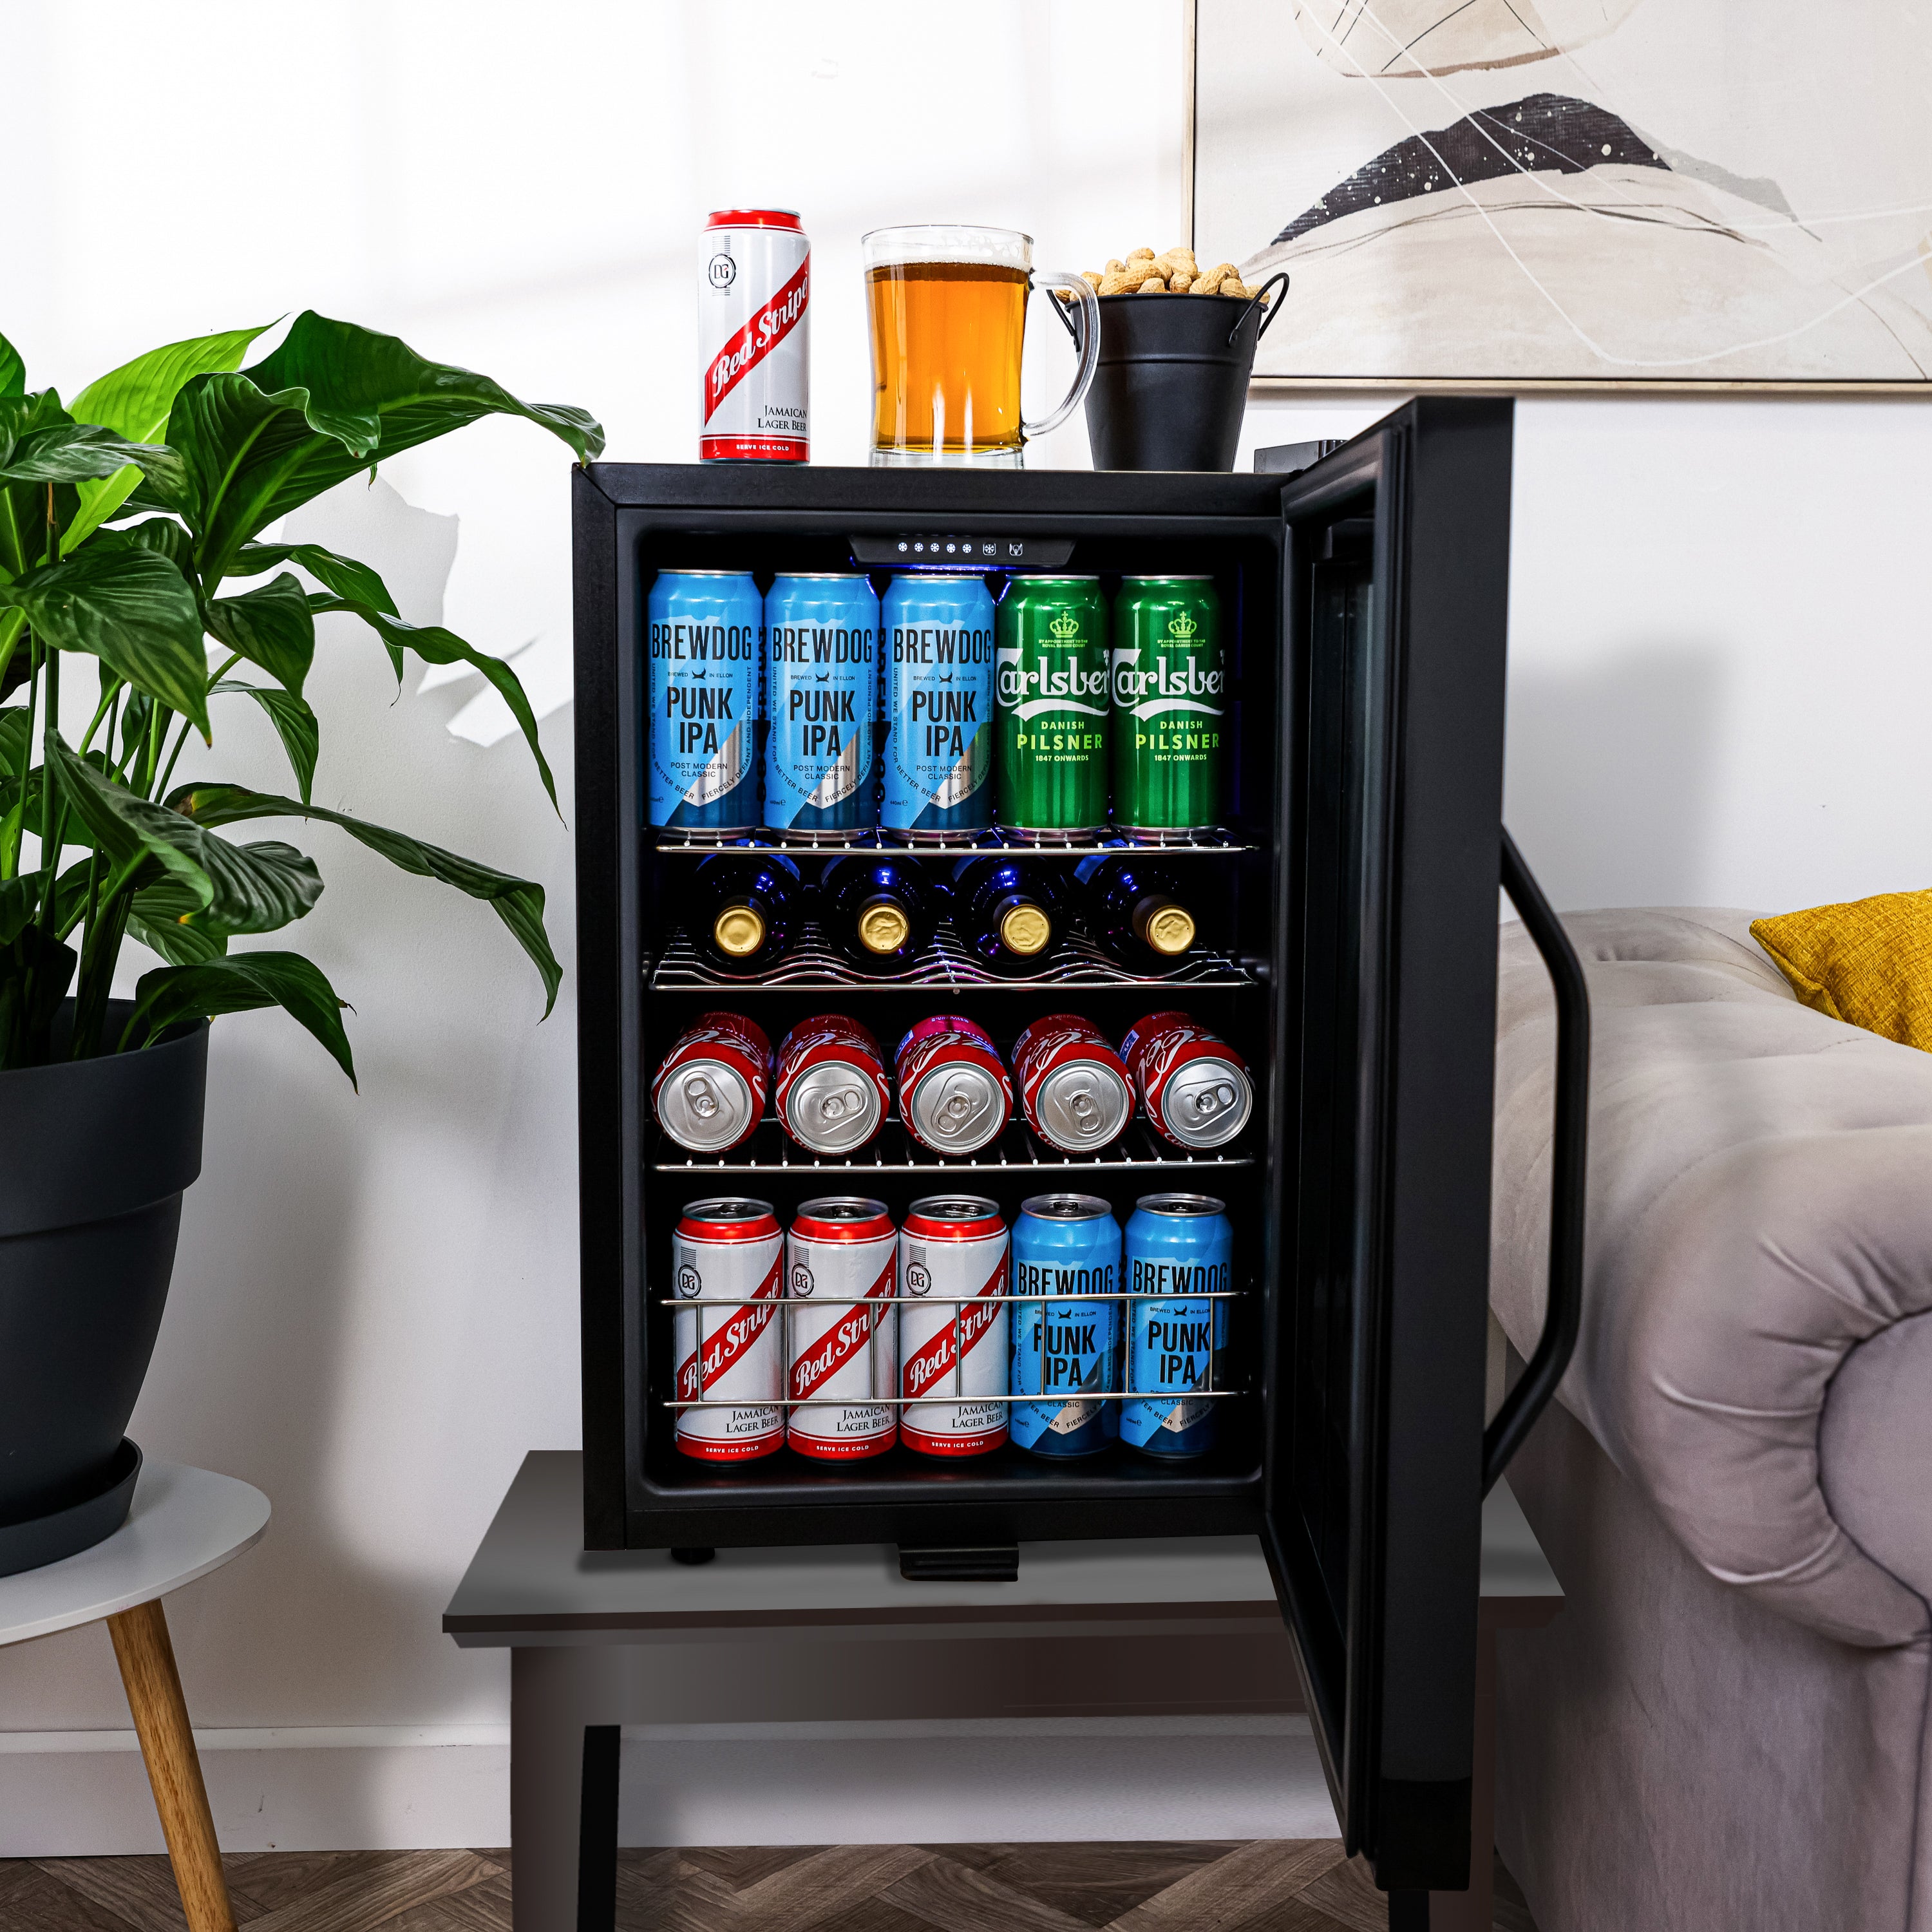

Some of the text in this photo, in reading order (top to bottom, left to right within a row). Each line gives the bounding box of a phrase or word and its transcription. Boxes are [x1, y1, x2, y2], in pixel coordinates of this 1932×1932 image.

[712, 277, 808, 397] Red Stripe
[757, 418, 807, 431] LAGER BEER
[764, 405, 807, 419] JAMAICAN
[652, 623, 752, 661] BREWDOG
[773, 627, 872, 663] BREWDOG
[894, 629, 991, 664] BREWDOG
[667, 687, 733, 719] PUNK
[790, 690, 855, 722] PUNK
[912, 690, 977, 722] PUNK
[679, 722, 719, 754] IPA
[803, 724, 842, 756] IPA
[926, 725, 964, 757] IPA
[1041, 721, 1084, 730] DANISH
[1160, 721, 1202, 729] DANISH
[772, 700, 777, 712] WE
[775, 764, 797, 790] BETTER
[797, 787, 819, 802] BEER
[893, 701, 898, 713] WE
[896, 766, 919, 790] BETTER
[921, 788, 941, 802] BEER
[1017, 734, 1102, 750] PILSNER
[1135, 733, 1219, 750] PILSNER
[654, 761, 674, 786] BETTER
[675, 784, 694, 799] BEER
[701, 777, 735, 800] FIERCELY
[735, 748, 751, 779] DEFIANT
[825, 779, 857, 803] FIERCELY
[857, 750, 871, 780] DEFIANT
[948, 780, 978, 803] FIERCELY
[1018, 1262, 1113, 1295] BREWDOG
[1133, 1259, 1227, 1293] BREWDOG
[795, 1278, 891, 1395] Red Strpe
[1148, 1320, 1211, 1352] PUNK
[684, 1342, 724, 1397] Red
[910, 1339, 951, 1392] Red
[1018, 1329, 1022, 1340] WE
[1041, 1413, 1059, 1428] BEER
[1045, 1357, 1083, 1387] IPA
[1132, 1327, 1135, 1338] WE
[1153, 1411, 1173, 1426] BEER
[1160, 1354, 1197, 1384] IPA
[726, 1416, 779, 1432] LAGER BEER
[732, 1405, 779, 1423] JAMAICAN
[837, 1416, 890, 1432] LAGER BEER
[842, 1404, 890, 1422] JAMAICAN
[952, 1417, 985, 1428] LAGER
[987, 1412, 1003, 1424] BEER
[958, 1402, 1003, 1418] JAMAICAN
[1066, 1406, 1097, 1428] FIERCELY
[1179, 1404, 1210, 1427] FIERCELY
